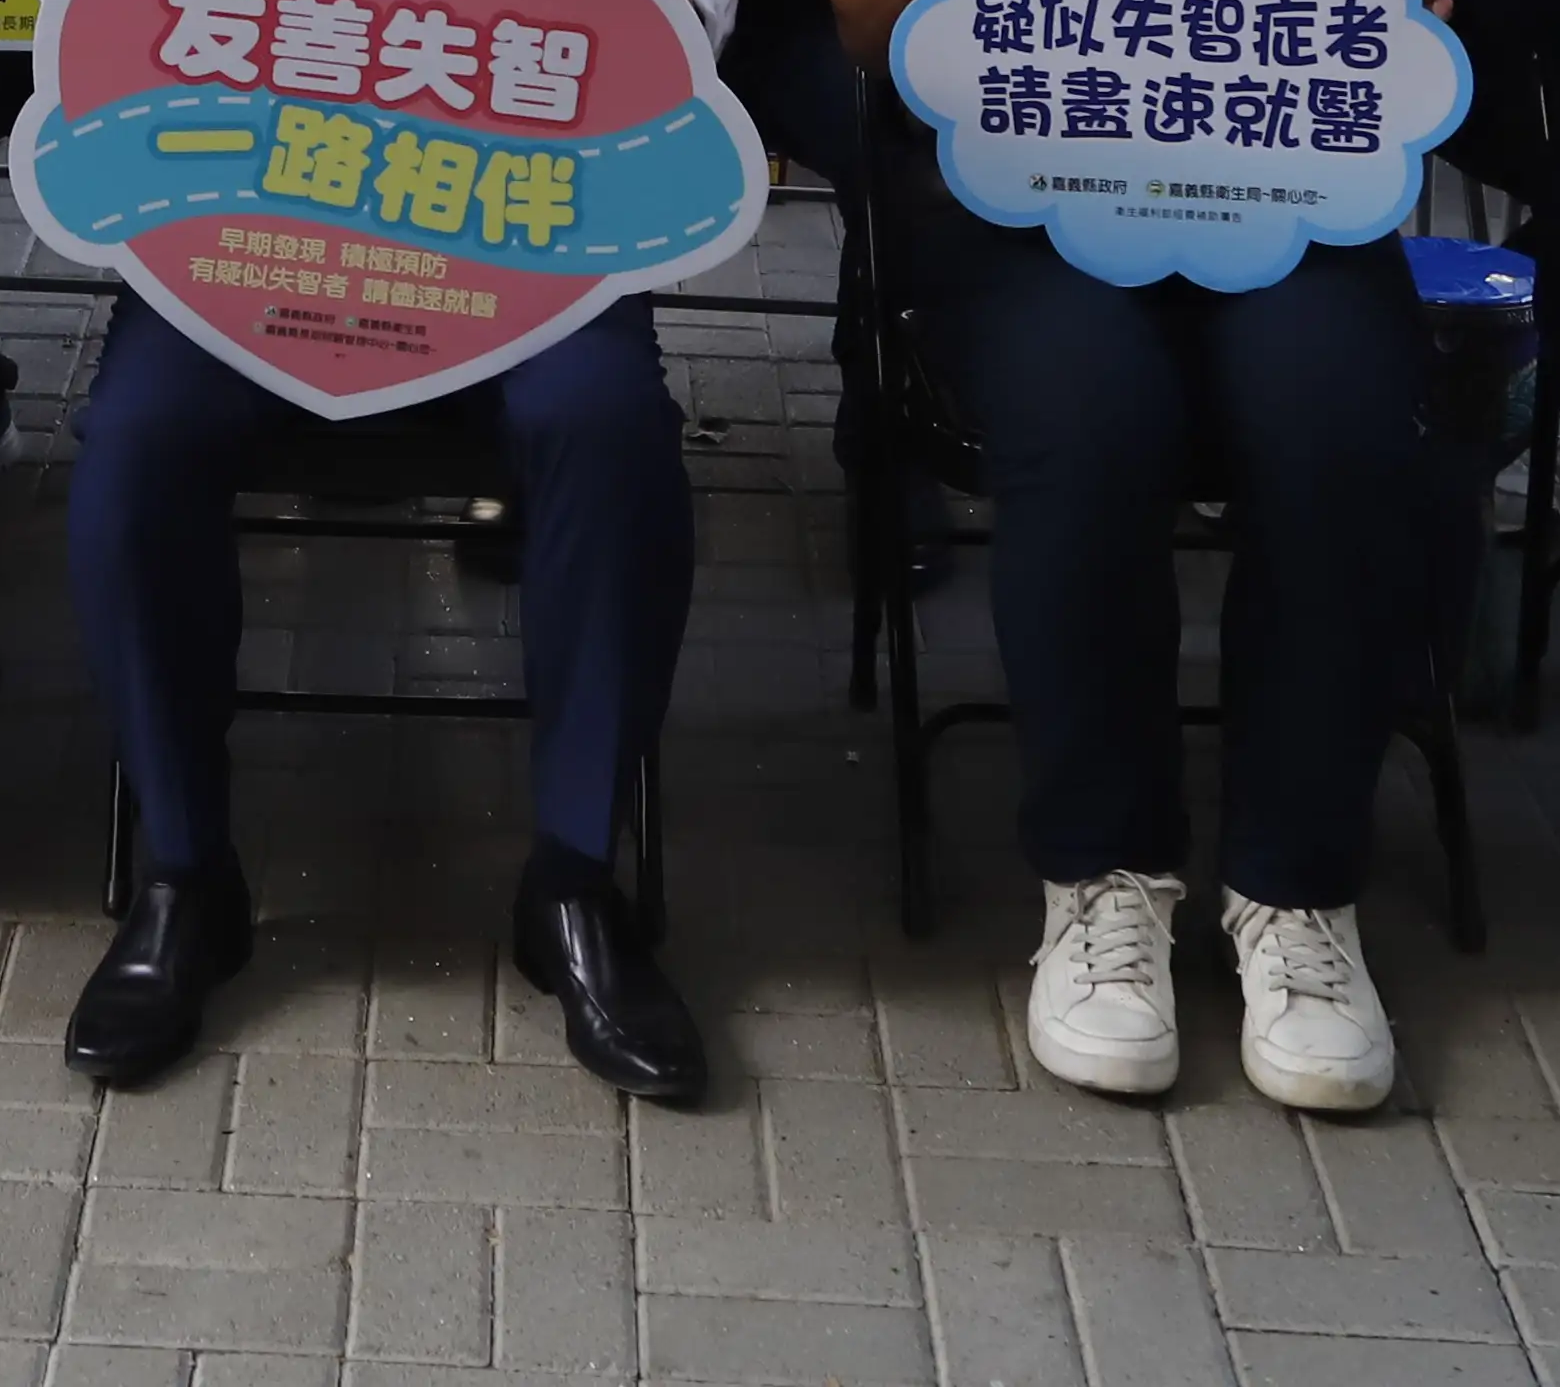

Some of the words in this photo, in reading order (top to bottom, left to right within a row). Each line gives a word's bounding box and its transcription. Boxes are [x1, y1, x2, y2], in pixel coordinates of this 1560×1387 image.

[977, 64, 1384, 155] 請盡速就醫
[155, 105, 580, 248] 一路相伴
[1050, 175, 1129, 197] 嘉義縣政府
[187, 255, 350, 300] 有疑似失智者
[218, 227, 327, 266] 早期發現
[339, 241, 448, 280] 積極預防
